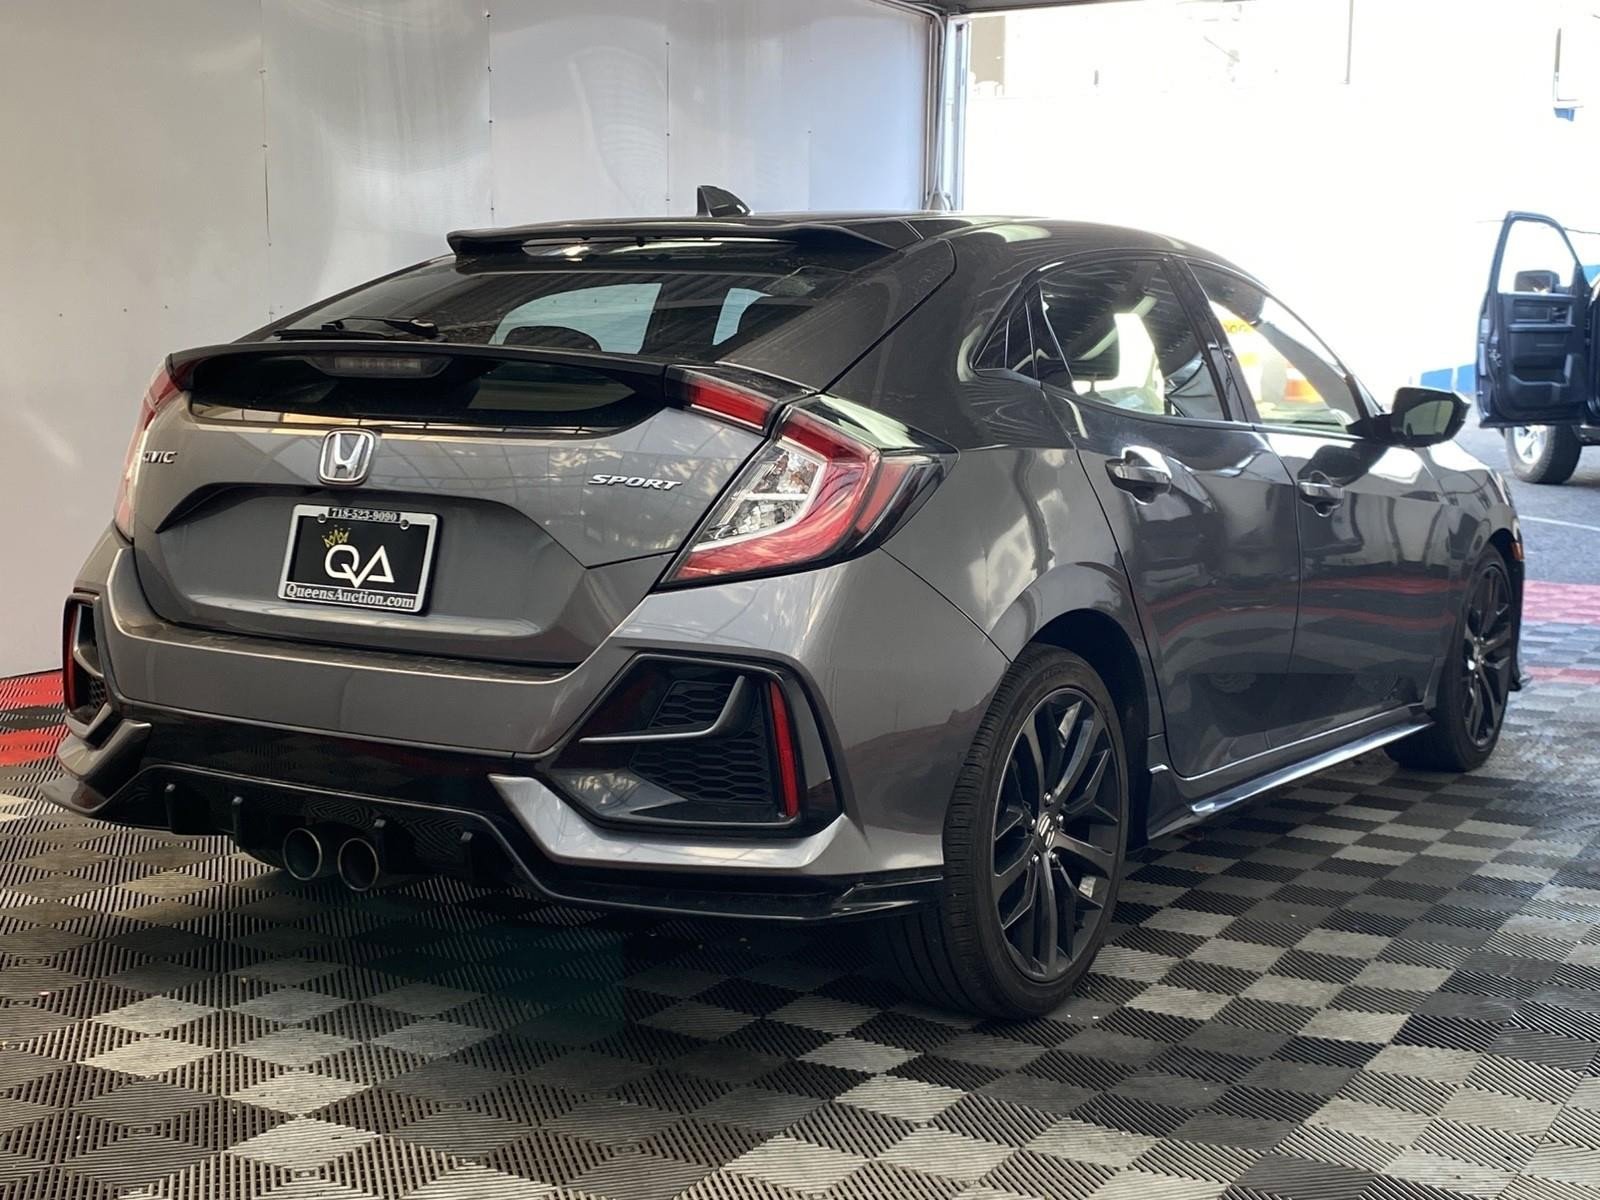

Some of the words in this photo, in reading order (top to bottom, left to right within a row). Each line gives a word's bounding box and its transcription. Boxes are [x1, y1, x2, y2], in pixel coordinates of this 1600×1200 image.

[588, 474, 682, 490] SPORT
[331, 507, 398, 522] 718-523-9090
[324, 544, 396, 588] QA
[286, 583, 415, 609] QueensAuction.com
